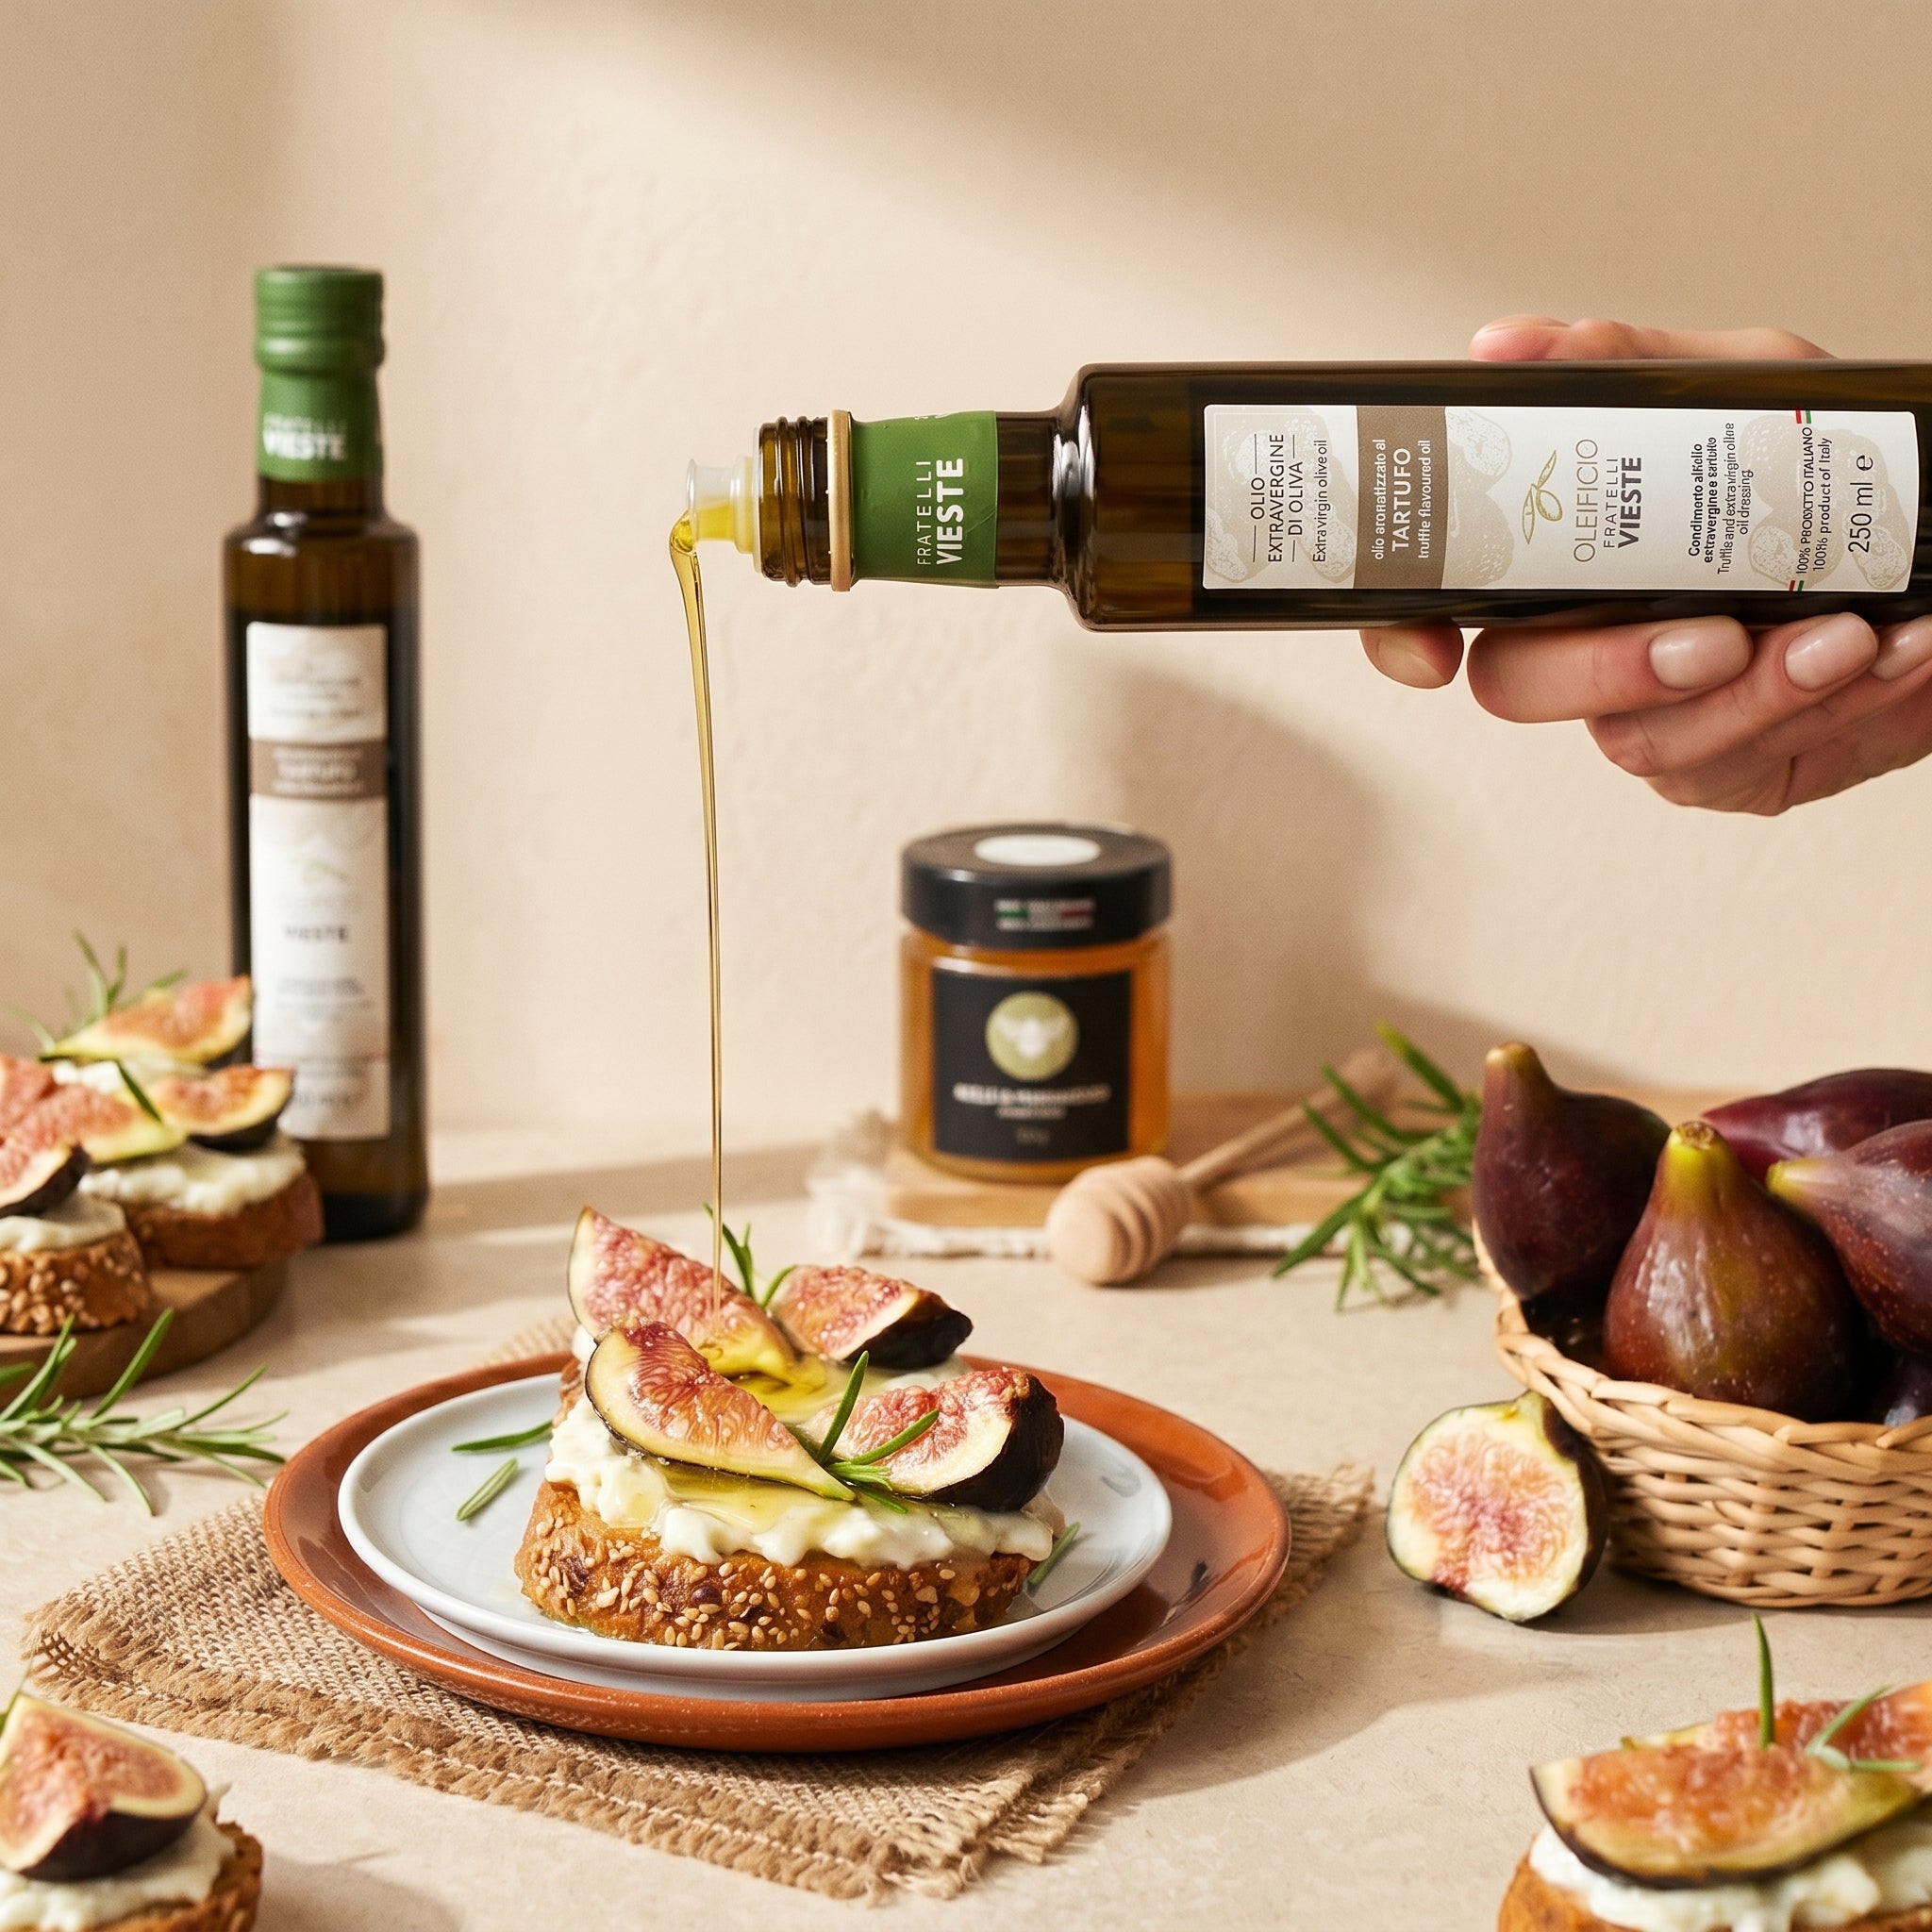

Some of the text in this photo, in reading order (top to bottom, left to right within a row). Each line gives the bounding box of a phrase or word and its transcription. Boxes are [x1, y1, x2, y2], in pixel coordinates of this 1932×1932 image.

[1372, 439, 1386, 450] al
[1418, 440, 1431, 454] oil
[1801, 426, 1814, 478] ITALIANO
[1817, 438, 1832, 463] Italy
[1250, 476, 1266, 520] OLIO
[1268, 434, 1285, 562] EXTRAVERGINE
[1288, 460, 1304, 536] DI OLIVA
[1418, 457, 1432, 518] flavoured
[1819, 467, 1831, 481] of
[1849, 482, 1874, 507] ml
[916, 461, 932, 565] FRATELLI
[936, 458, 964, 565] VIESTE
[1312, 440, 1331, 563] Extra virgin olive oil
[1391, 448, 1411, 552] TARTUFO
[1574, 439, 1599, 563] OLEIFICIO
[1603, 458, 1619, 548] FRATELLI
[1618, 458, 1642, 549] VIESTE
[1817, 483, 1832, 534] product
[1372, 538, 1384, 560] olio
[1723, 518, 1735, 541] and
[1737, 520, 1749, 535] oil
[1848, 512, 1873, 553] 250
